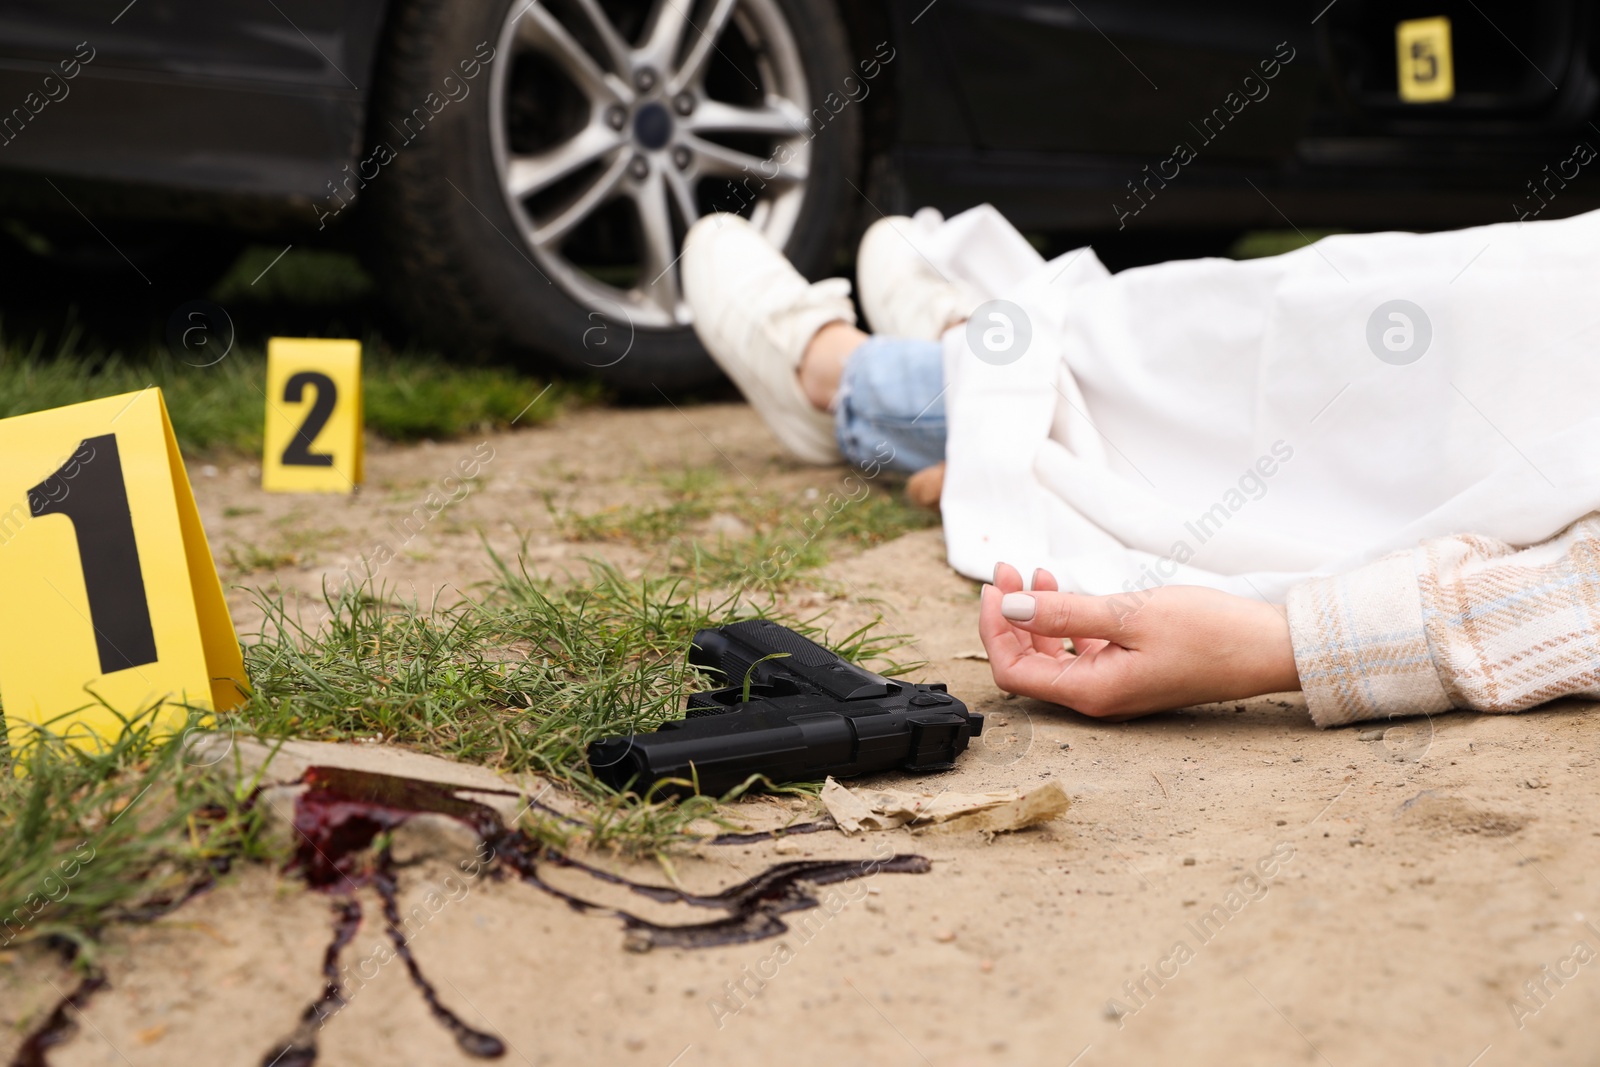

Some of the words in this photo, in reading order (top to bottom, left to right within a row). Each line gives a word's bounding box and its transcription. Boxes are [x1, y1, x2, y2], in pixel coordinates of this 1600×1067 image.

[1410, 42, 1440, 83] 5
[281, 371, 338, 467] 2
[26, 433, 159, 675] 1
